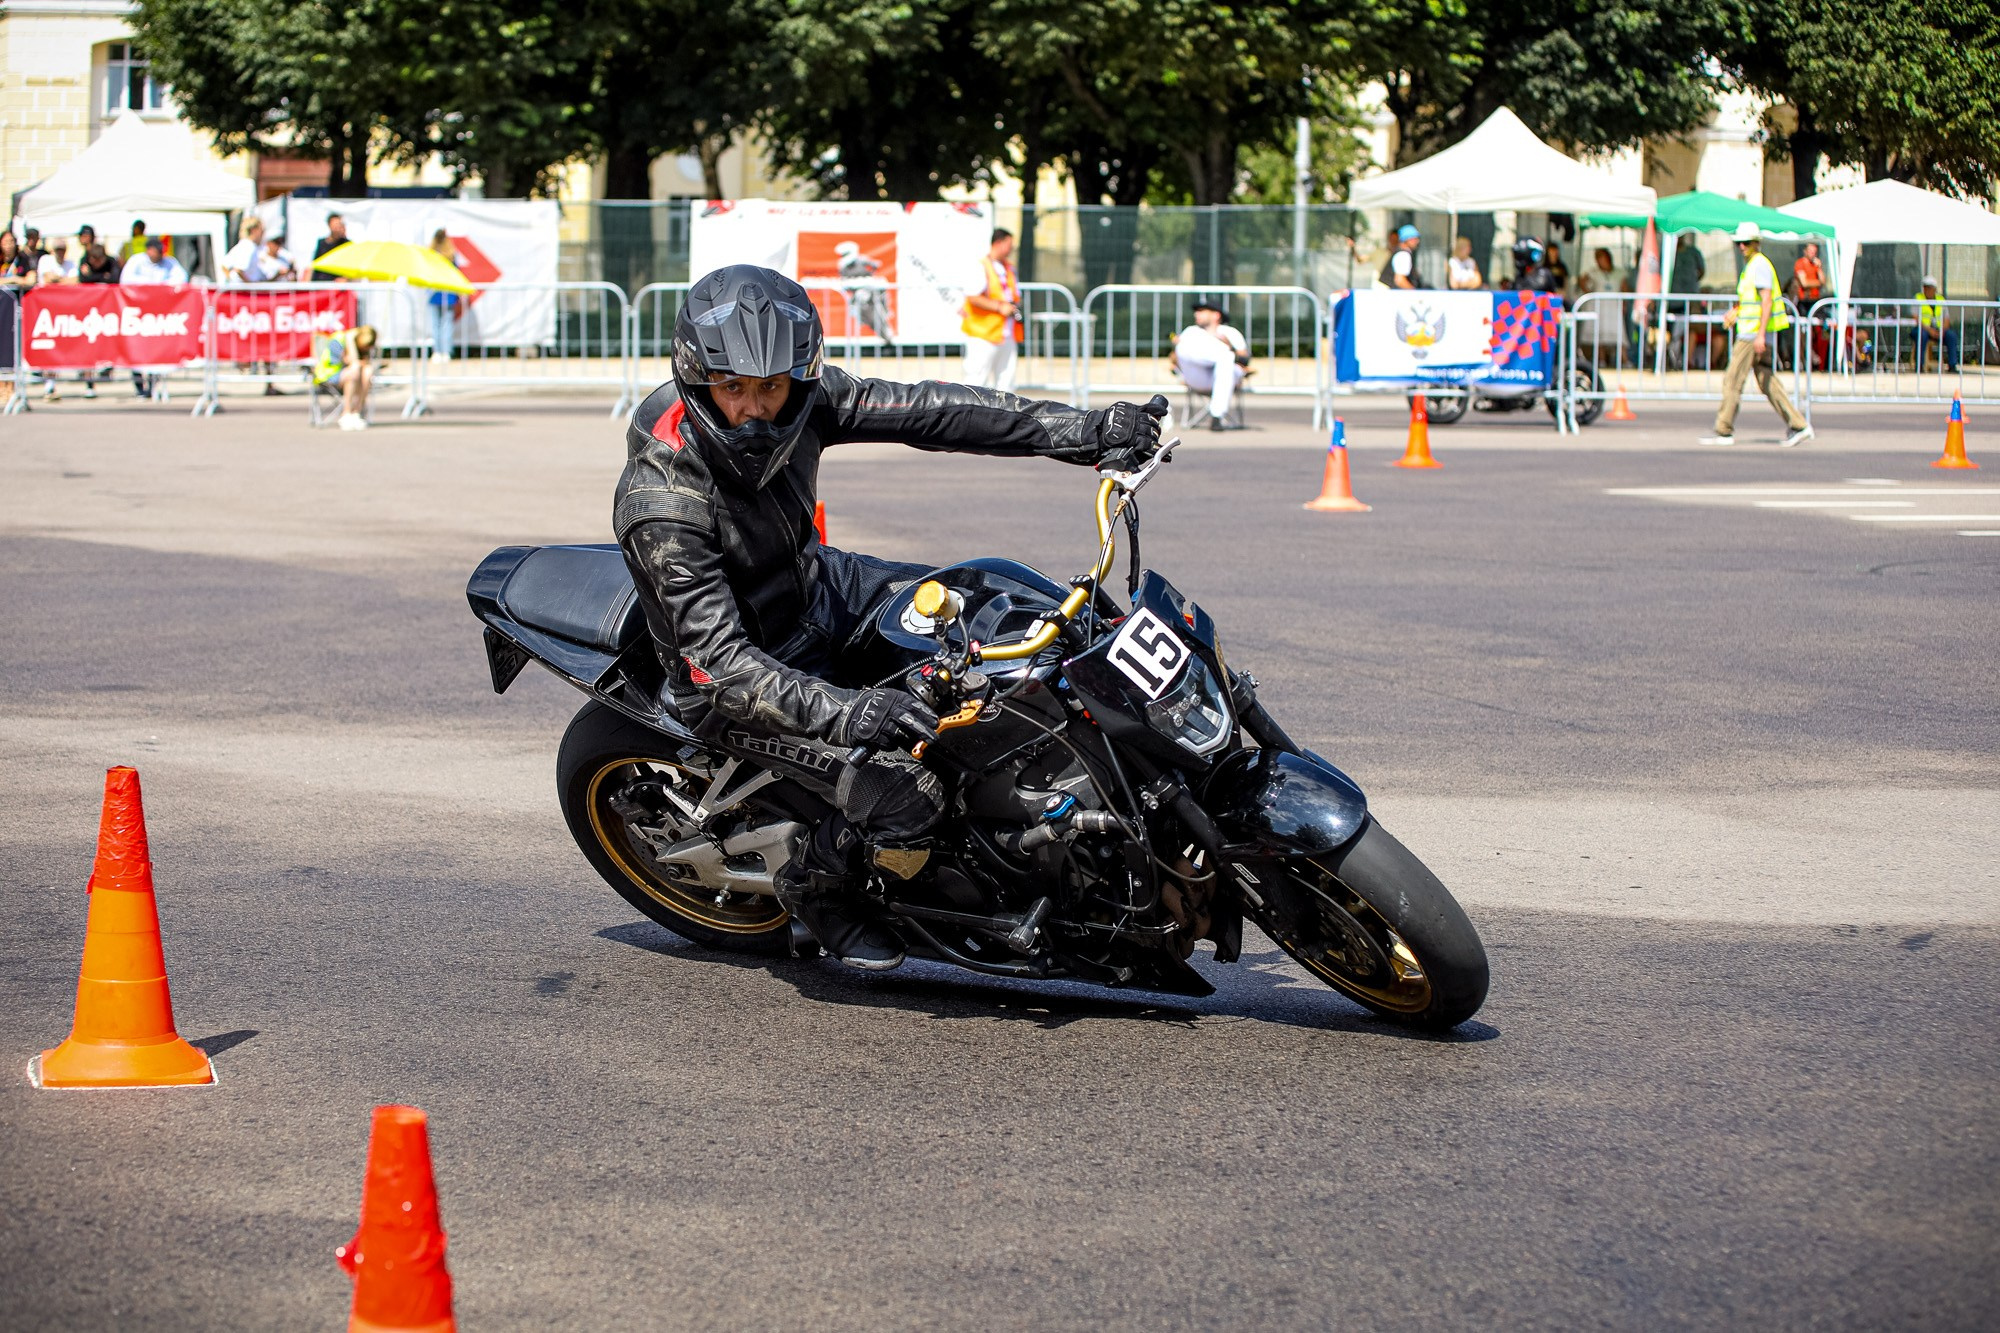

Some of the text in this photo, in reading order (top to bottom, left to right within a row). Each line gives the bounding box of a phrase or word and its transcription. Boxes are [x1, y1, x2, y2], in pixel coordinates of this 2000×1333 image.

[31, 306, 189, 349] Альфа Банк
[200, 305, 344, 340] ьфа Банк
[1116, 616, 1182, 693] 15
[728, 730, 836, 773] Taichi
